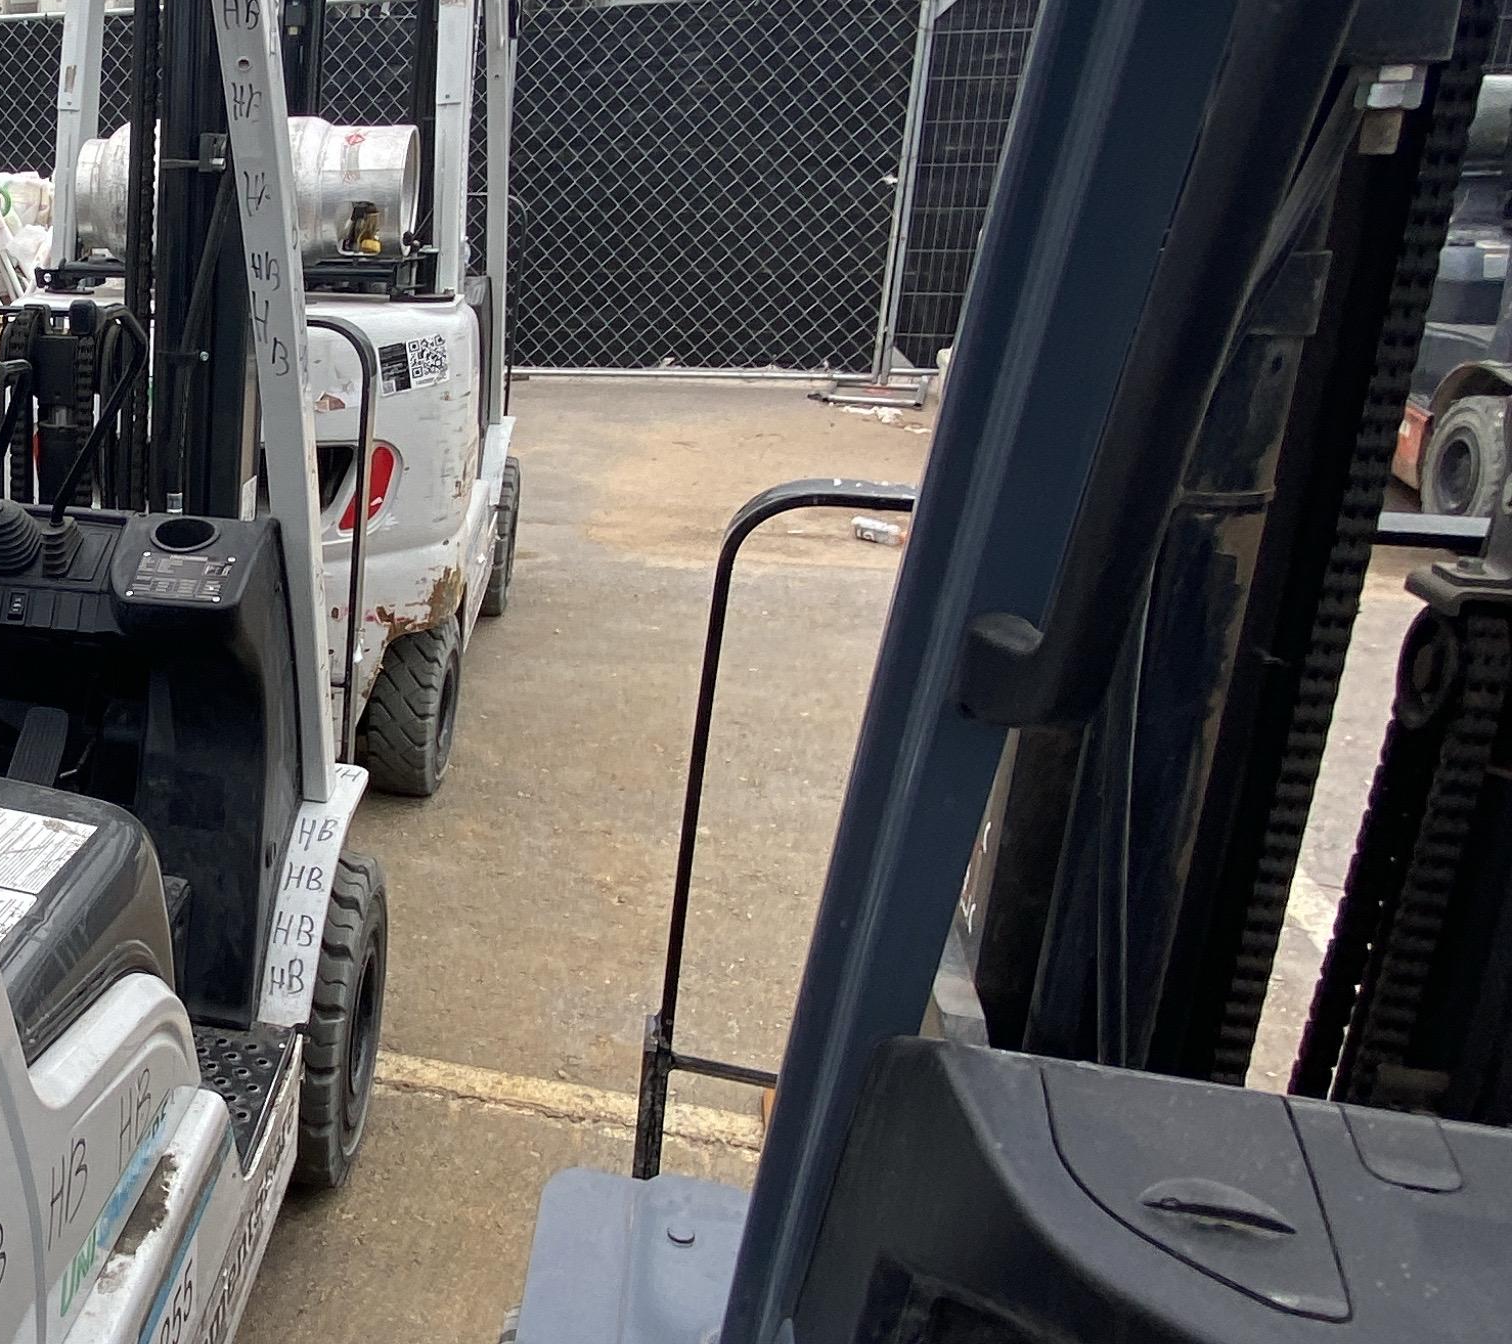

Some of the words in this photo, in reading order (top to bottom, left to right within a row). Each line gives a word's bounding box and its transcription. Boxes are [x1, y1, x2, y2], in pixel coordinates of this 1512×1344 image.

[299, 817, 338, 851] HB
[283, 862, 323, 892] HB
[273, 911, 314, 947] HB
